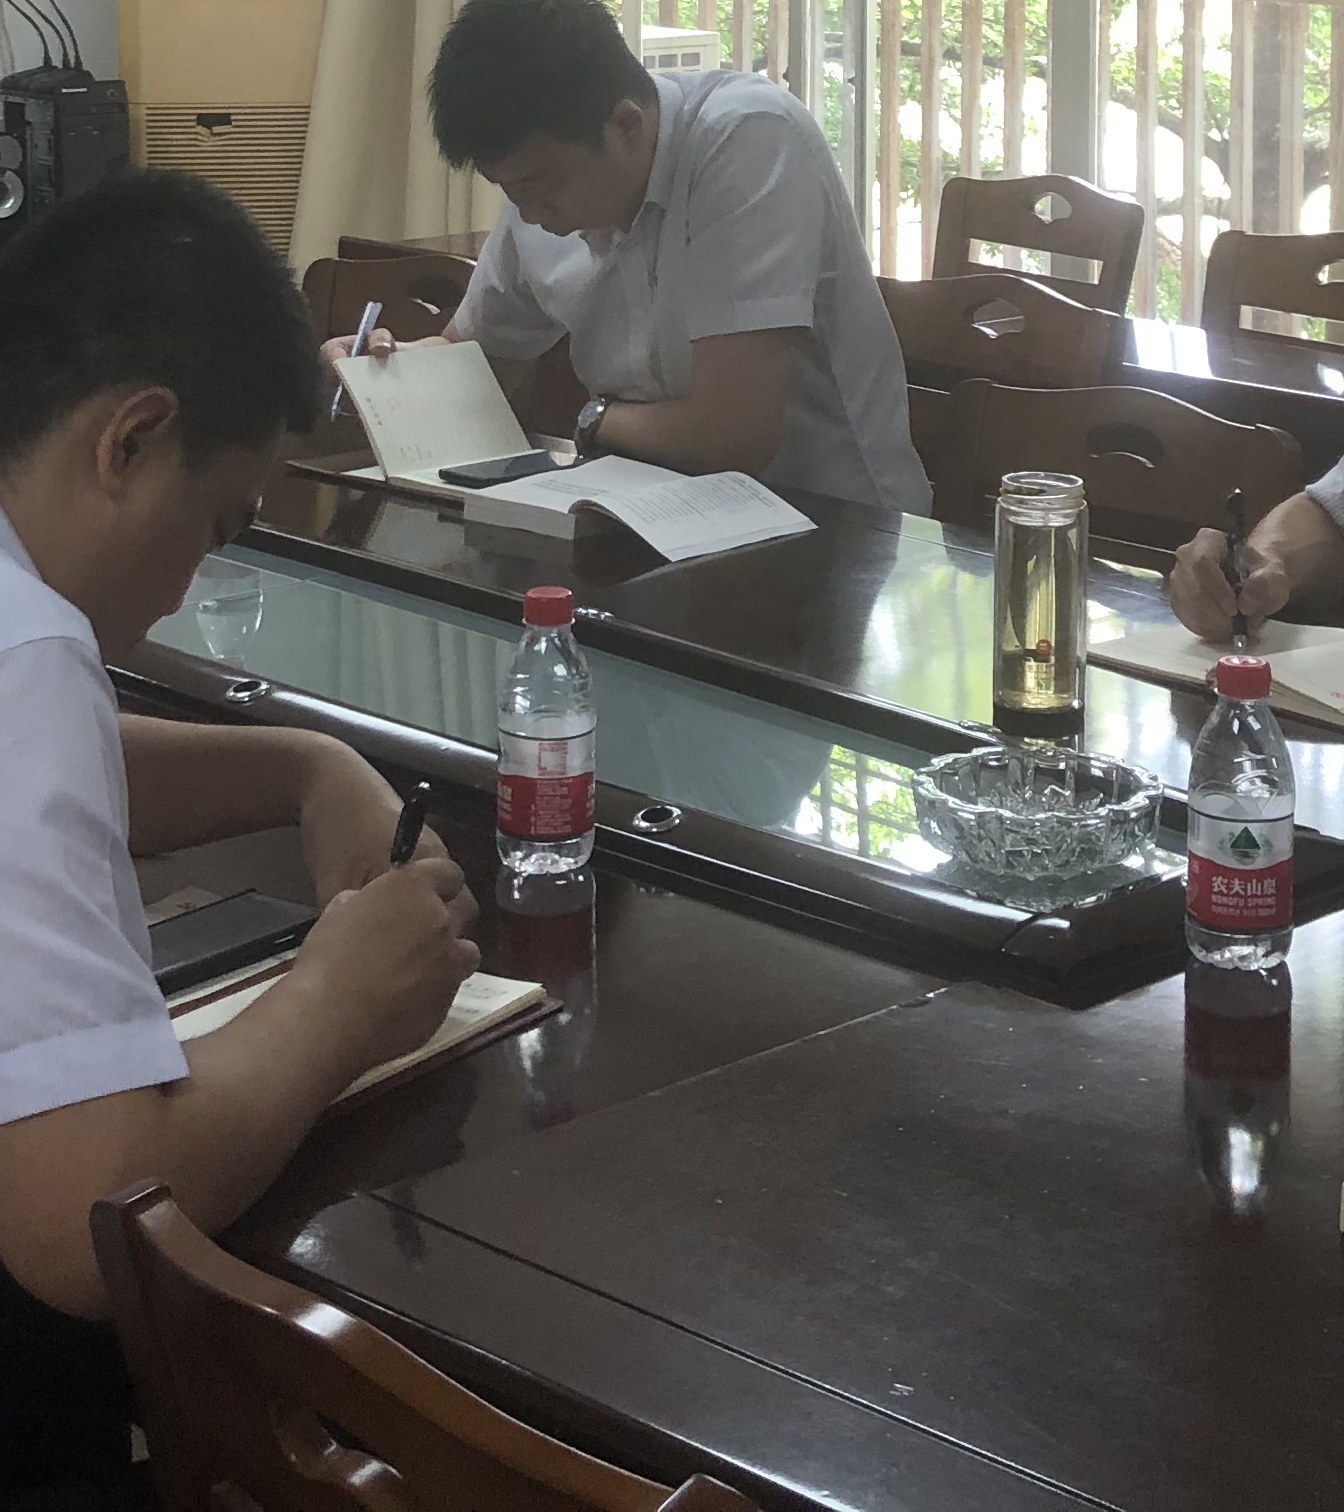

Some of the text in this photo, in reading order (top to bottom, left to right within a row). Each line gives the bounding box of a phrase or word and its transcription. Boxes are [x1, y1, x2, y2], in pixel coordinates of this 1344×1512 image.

[1211, 875, 1277, 897] 农夫山泉
[1211, 894, 1276, 907] NONGFU SPRING
